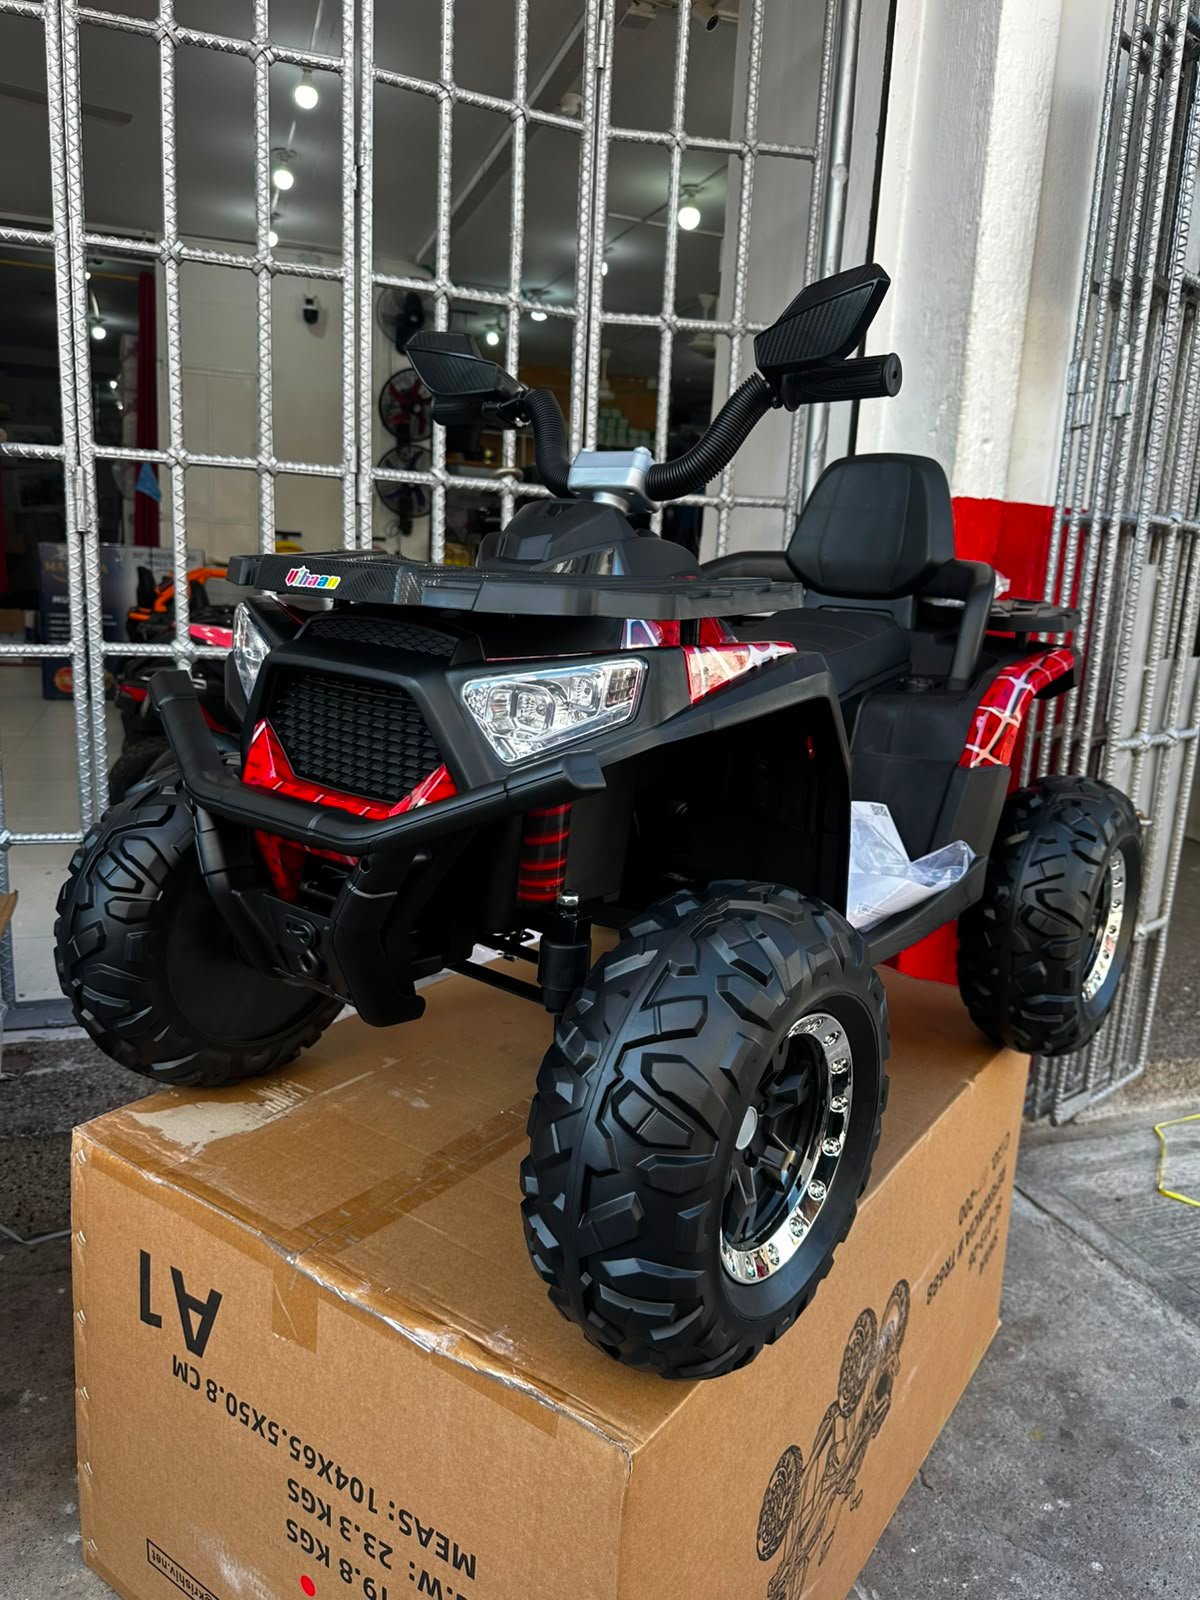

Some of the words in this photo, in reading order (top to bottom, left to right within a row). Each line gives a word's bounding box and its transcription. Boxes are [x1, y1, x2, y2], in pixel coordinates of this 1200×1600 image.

[286, 565, 341, 590] Vihaan
[140, 1248, 222, 1358] A1
[172, 1354, 201, 1390] CM
[206, 1379, 378, 1514] 104X65.5X50.8
[287, 1478, 331, 1527] KGS
[286, 1518, 330, 1568] KGS
[339, 1516, 393, 1570] 23.3
[388, 1501, 476, 1580] MEAS:
